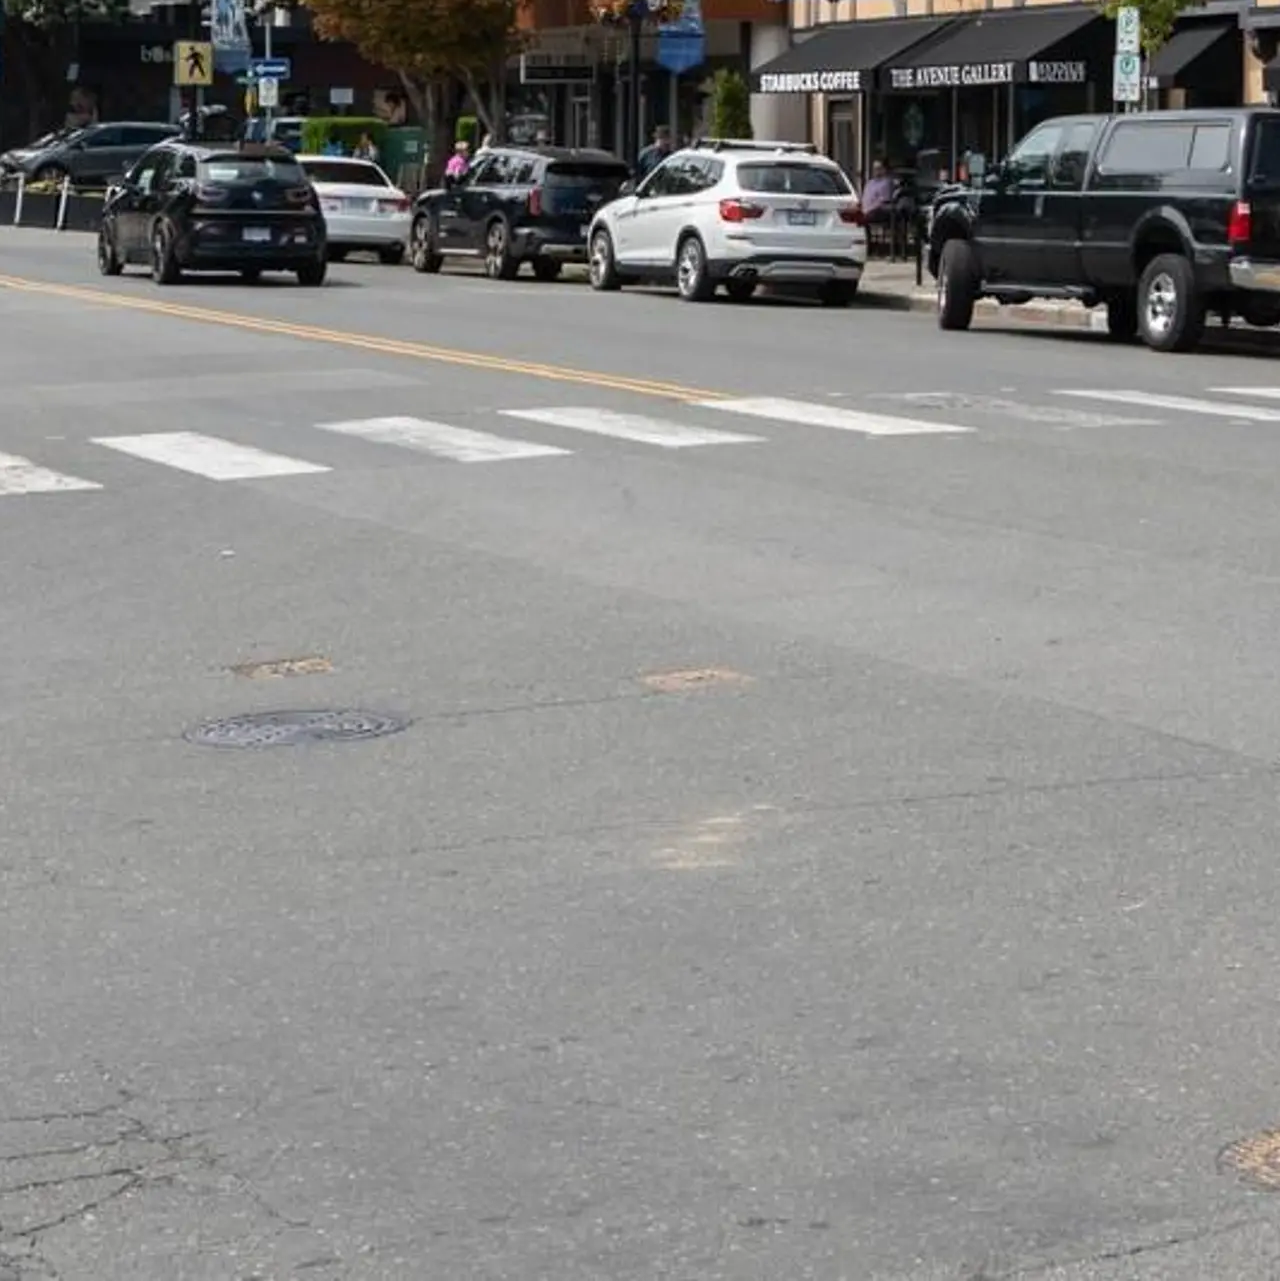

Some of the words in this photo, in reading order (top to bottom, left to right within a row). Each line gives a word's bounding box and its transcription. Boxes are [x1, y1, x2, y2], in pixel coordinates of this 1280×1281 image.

[760, 71, 819, 93] STARBUCKS
[819, 70, 861, 91] COFFEE
[890, 68, 914, 88] THE
[915, 65, 960, 87] AVENUE
[961, 61, 1016, 84] GALLERY
